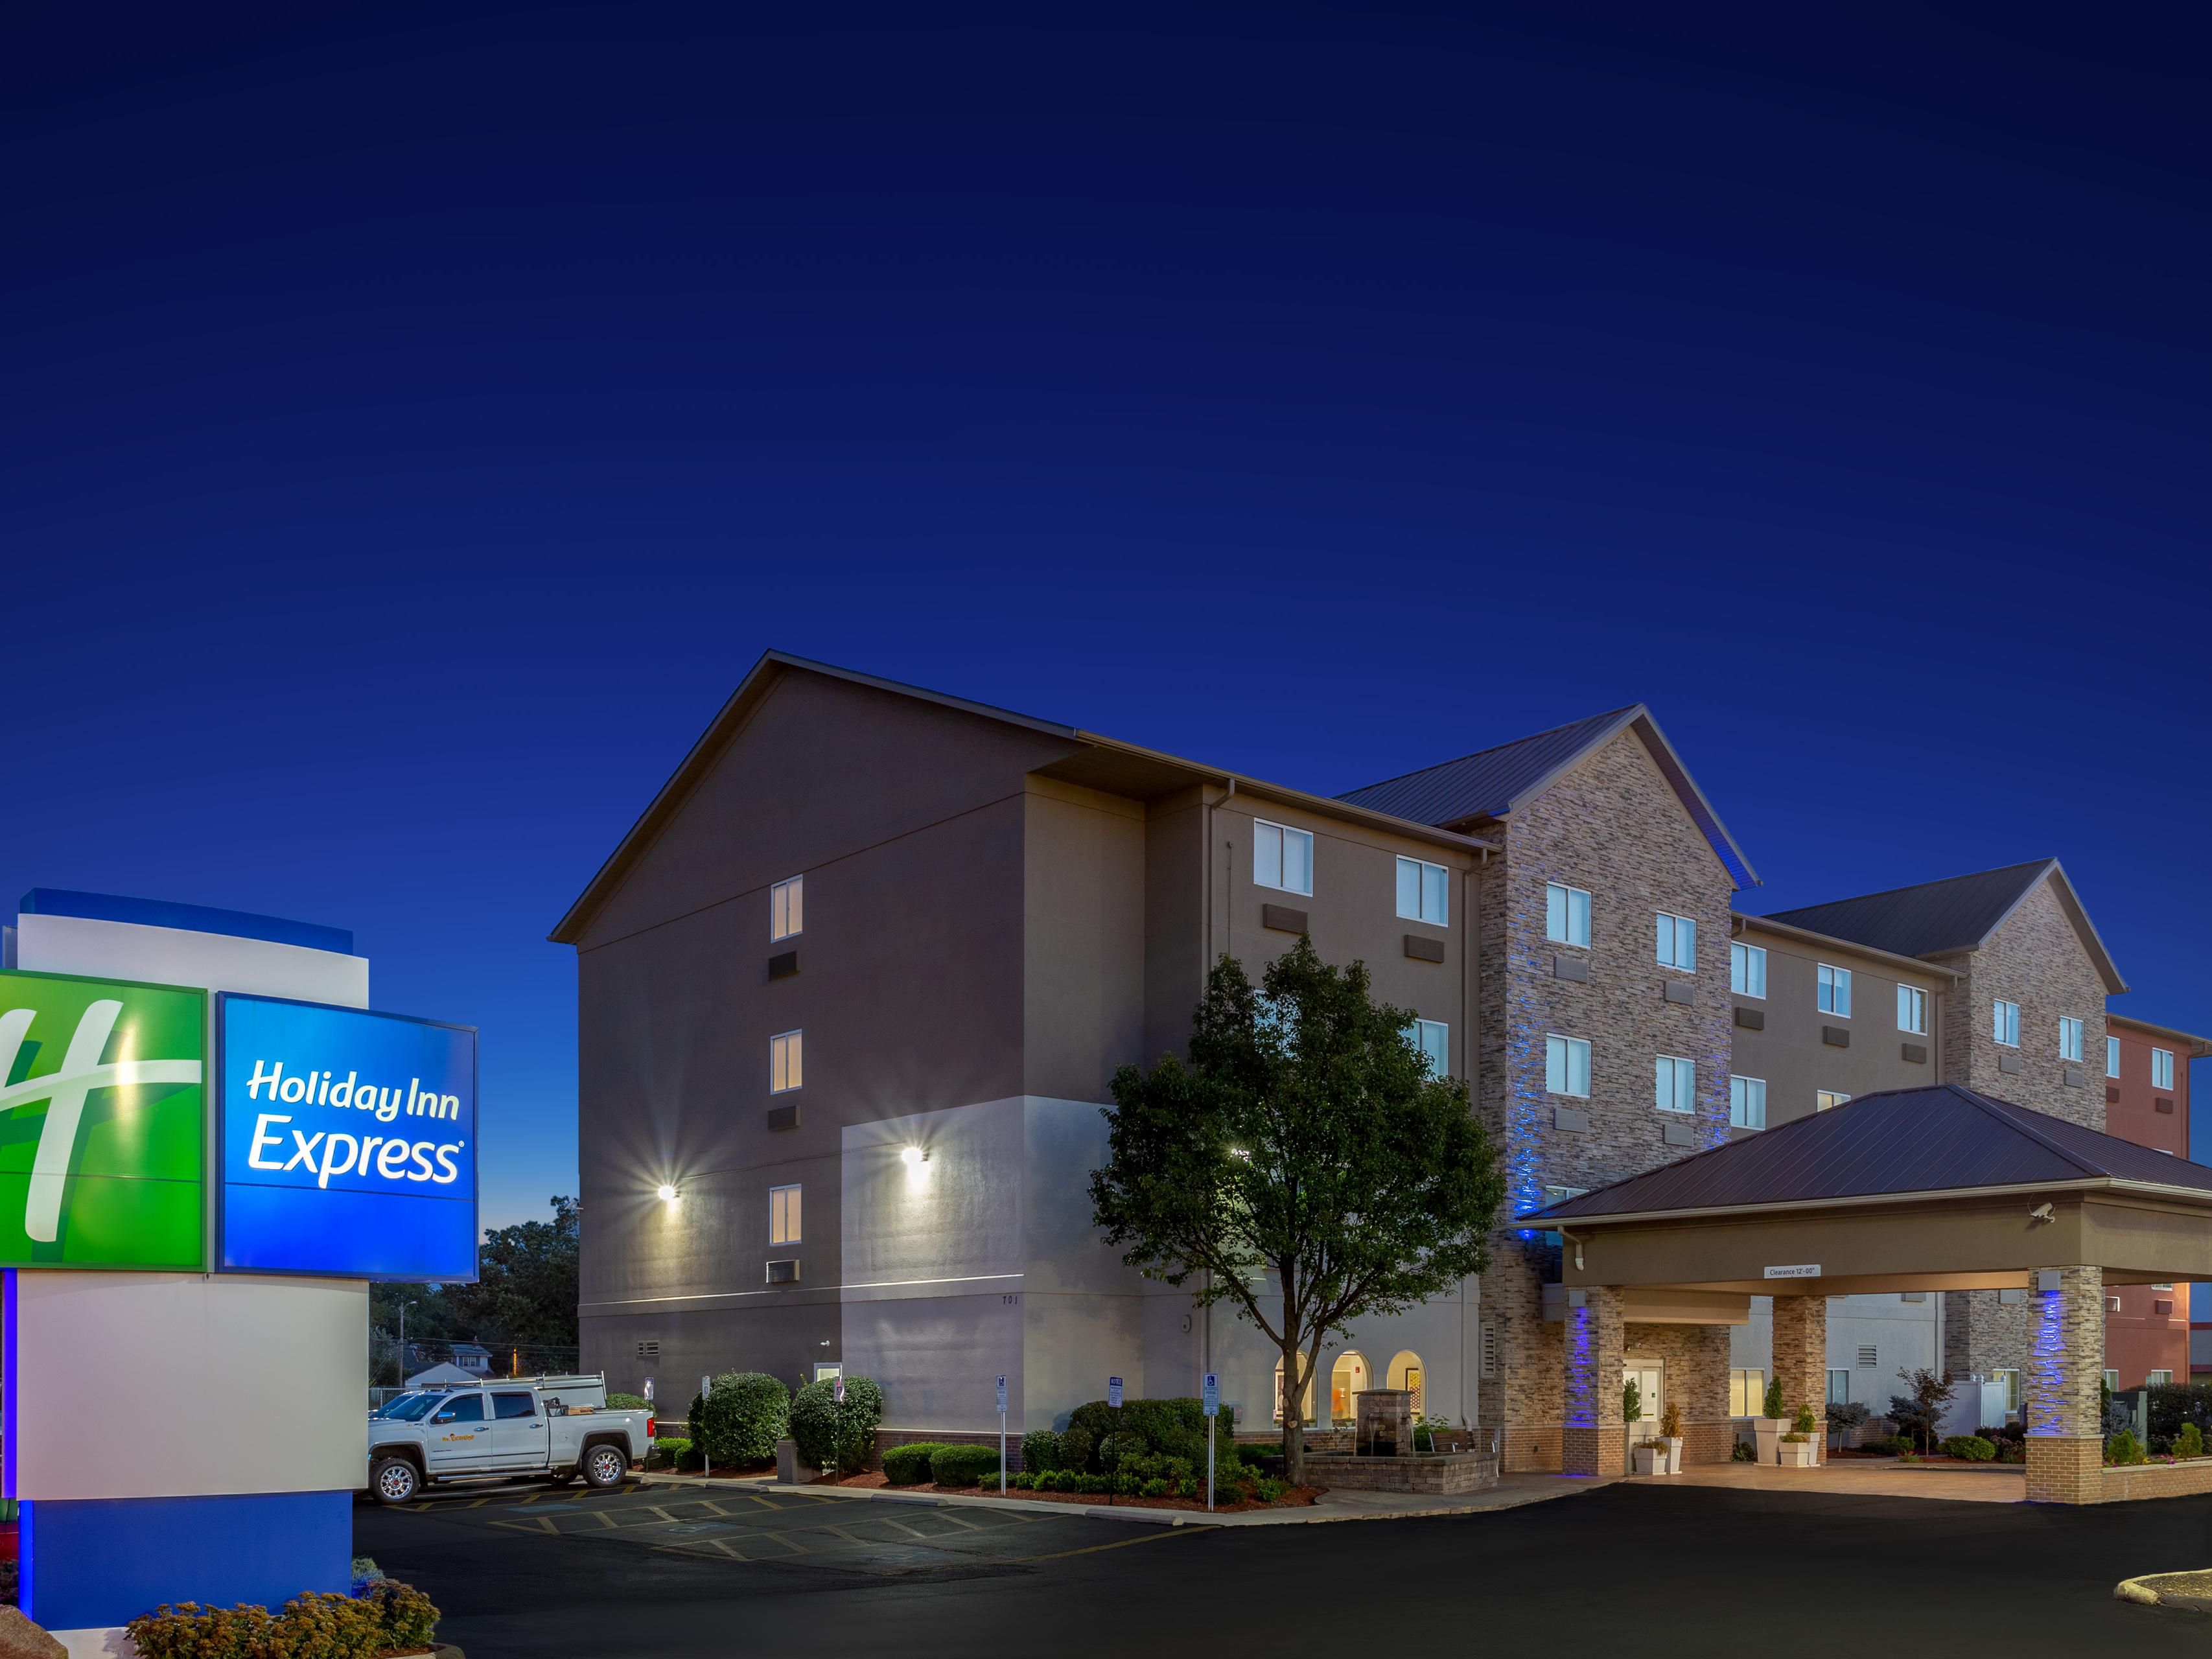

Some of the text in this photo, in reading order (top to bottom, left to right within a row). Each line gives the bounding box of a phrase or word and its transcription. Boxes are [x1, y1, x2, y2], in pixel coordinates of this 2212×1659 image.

[246, 1060, 459, 1122] Holiday Inn
[248, 1113, 460, 1189] Express
[1003, 1295, 1018, 1305] 701
